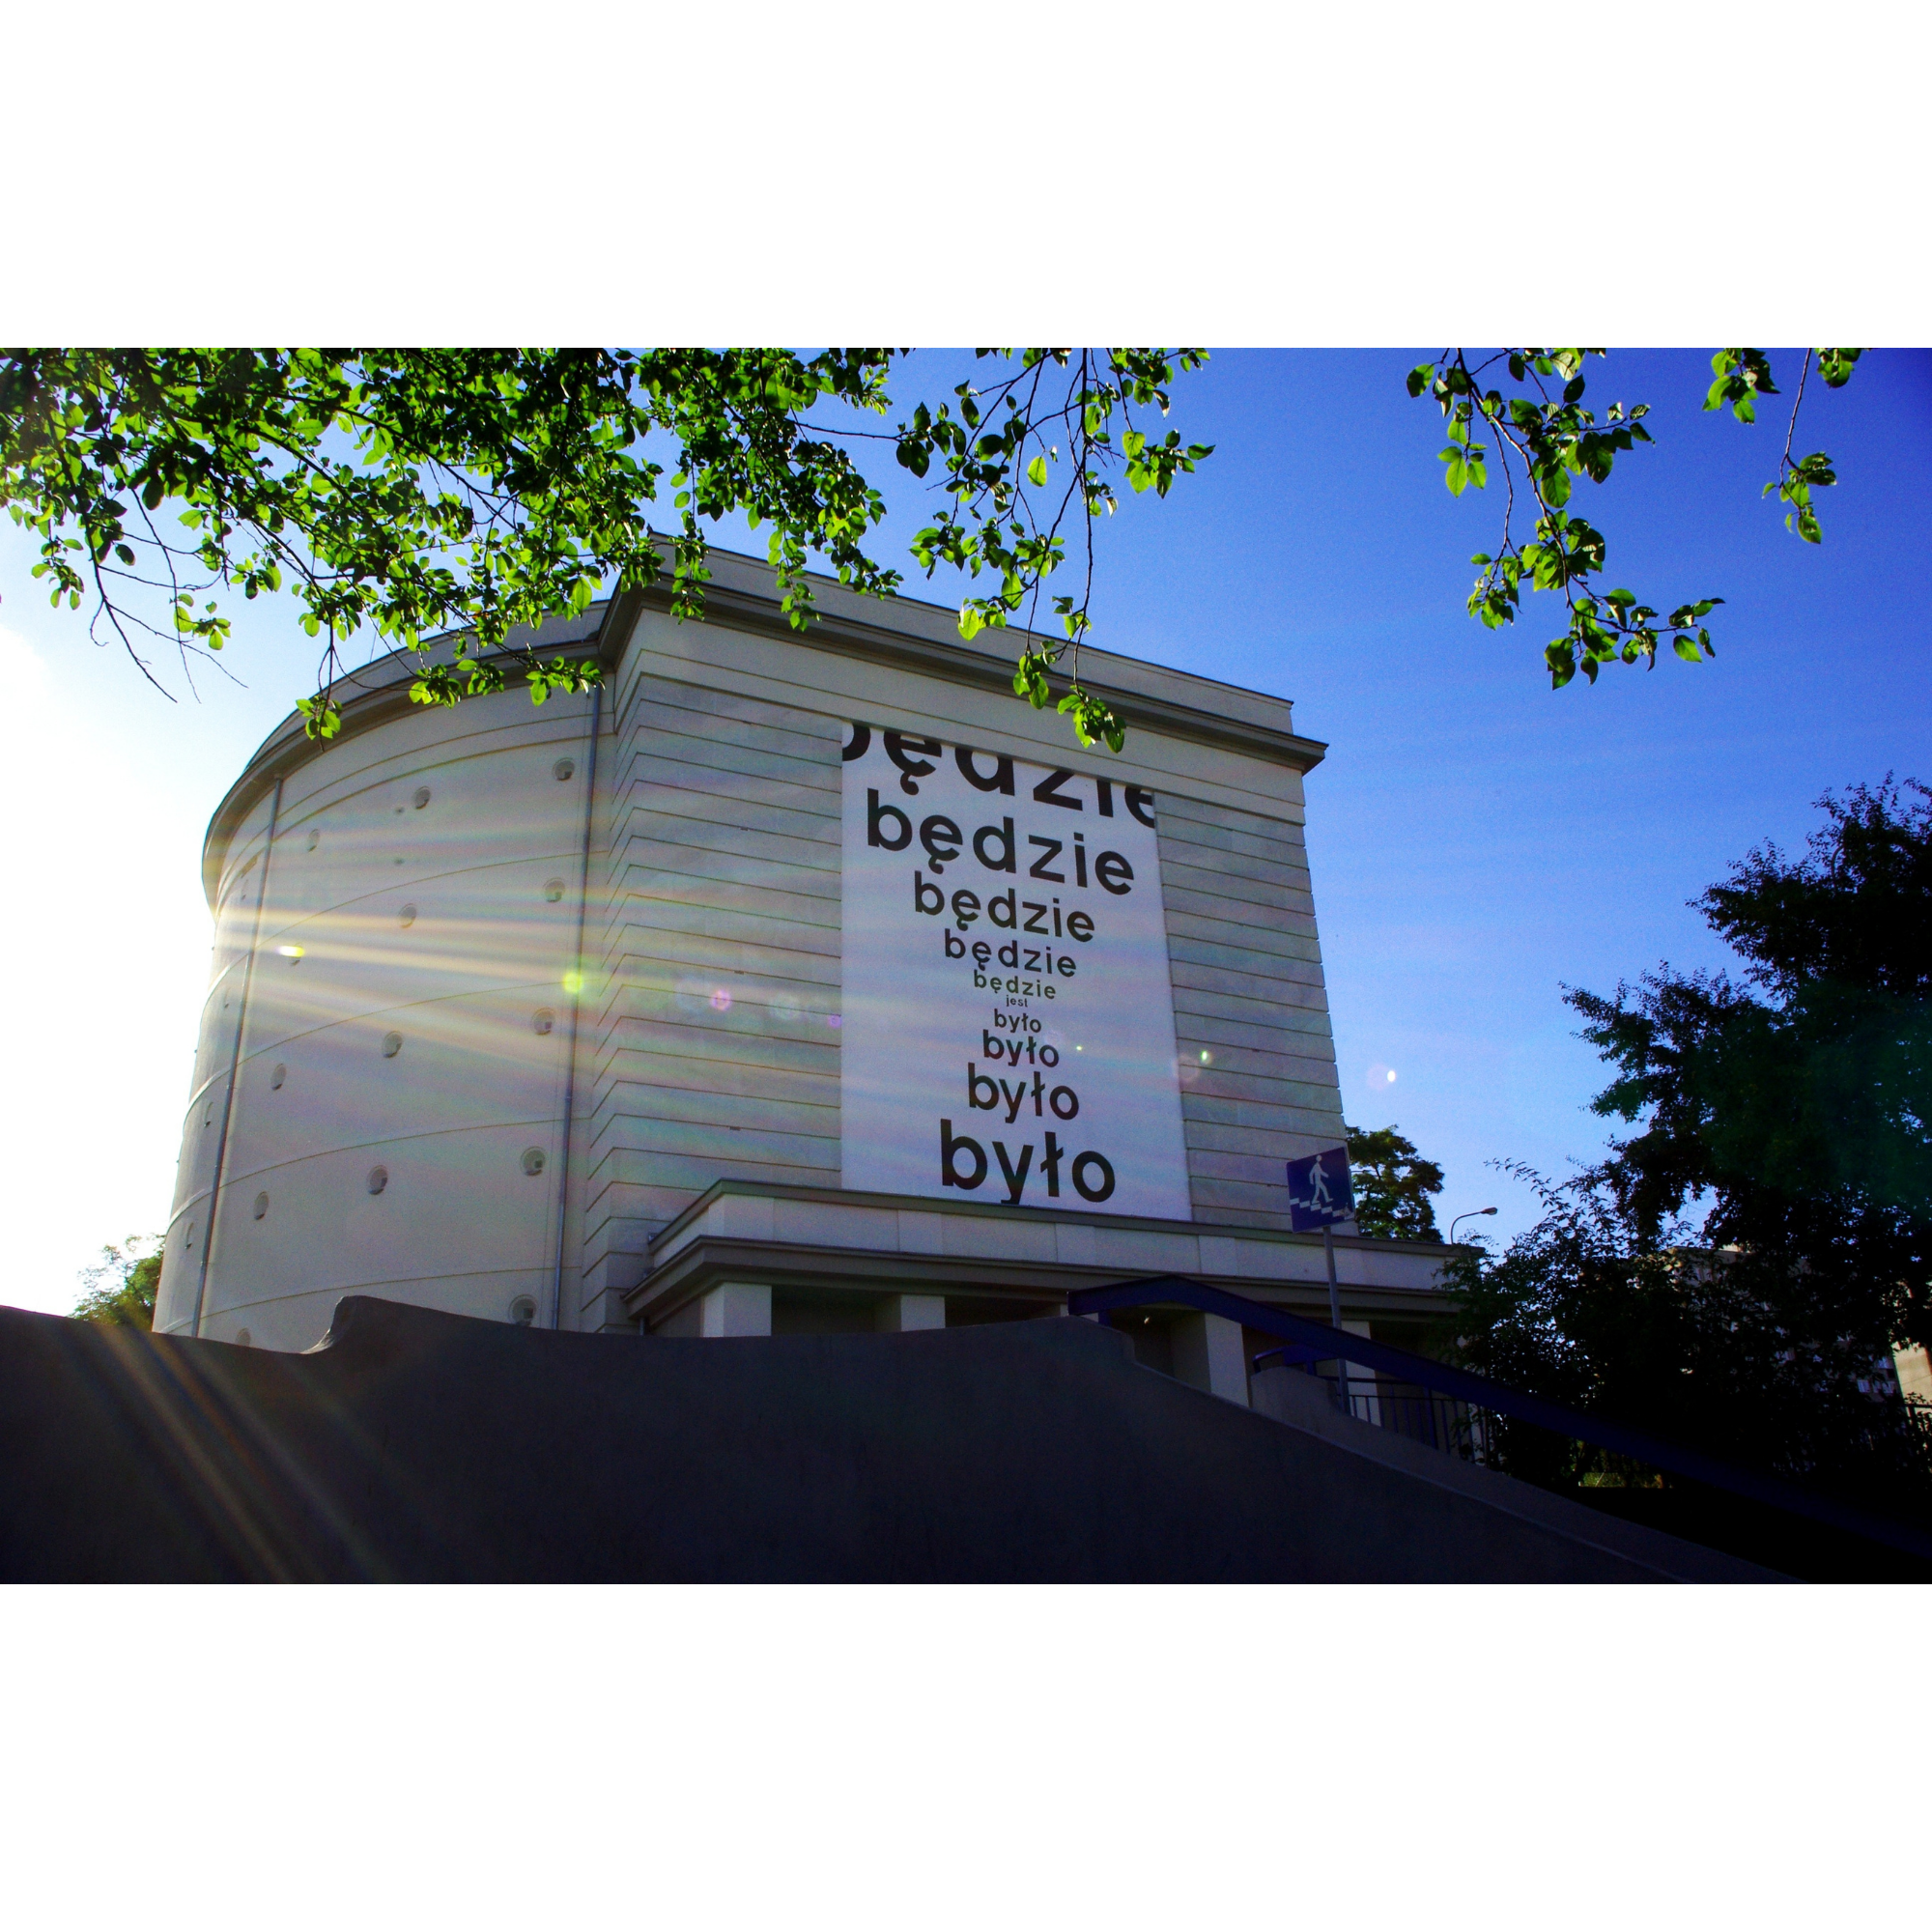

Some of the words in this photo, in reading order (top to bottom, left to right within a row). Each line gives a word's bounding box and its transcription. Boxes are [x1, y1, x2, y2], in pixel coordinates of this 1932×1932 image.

[842, 723, 1154, 829] ędzi
[867, 788, 1134, 895] będzie
[914, 870, 1094, 943] będzie
[945, 928, 1076, 978] będzie
[974, 969, 1056, 999] będzie
[1006, 994, 1028, 1008] jest
[983, 1029, 1059, 1067] było
[994, 1009, 1041, 1033] było
[968, 1063, 1079, 1123] było
[941, 1119, 1115, 1205] było
